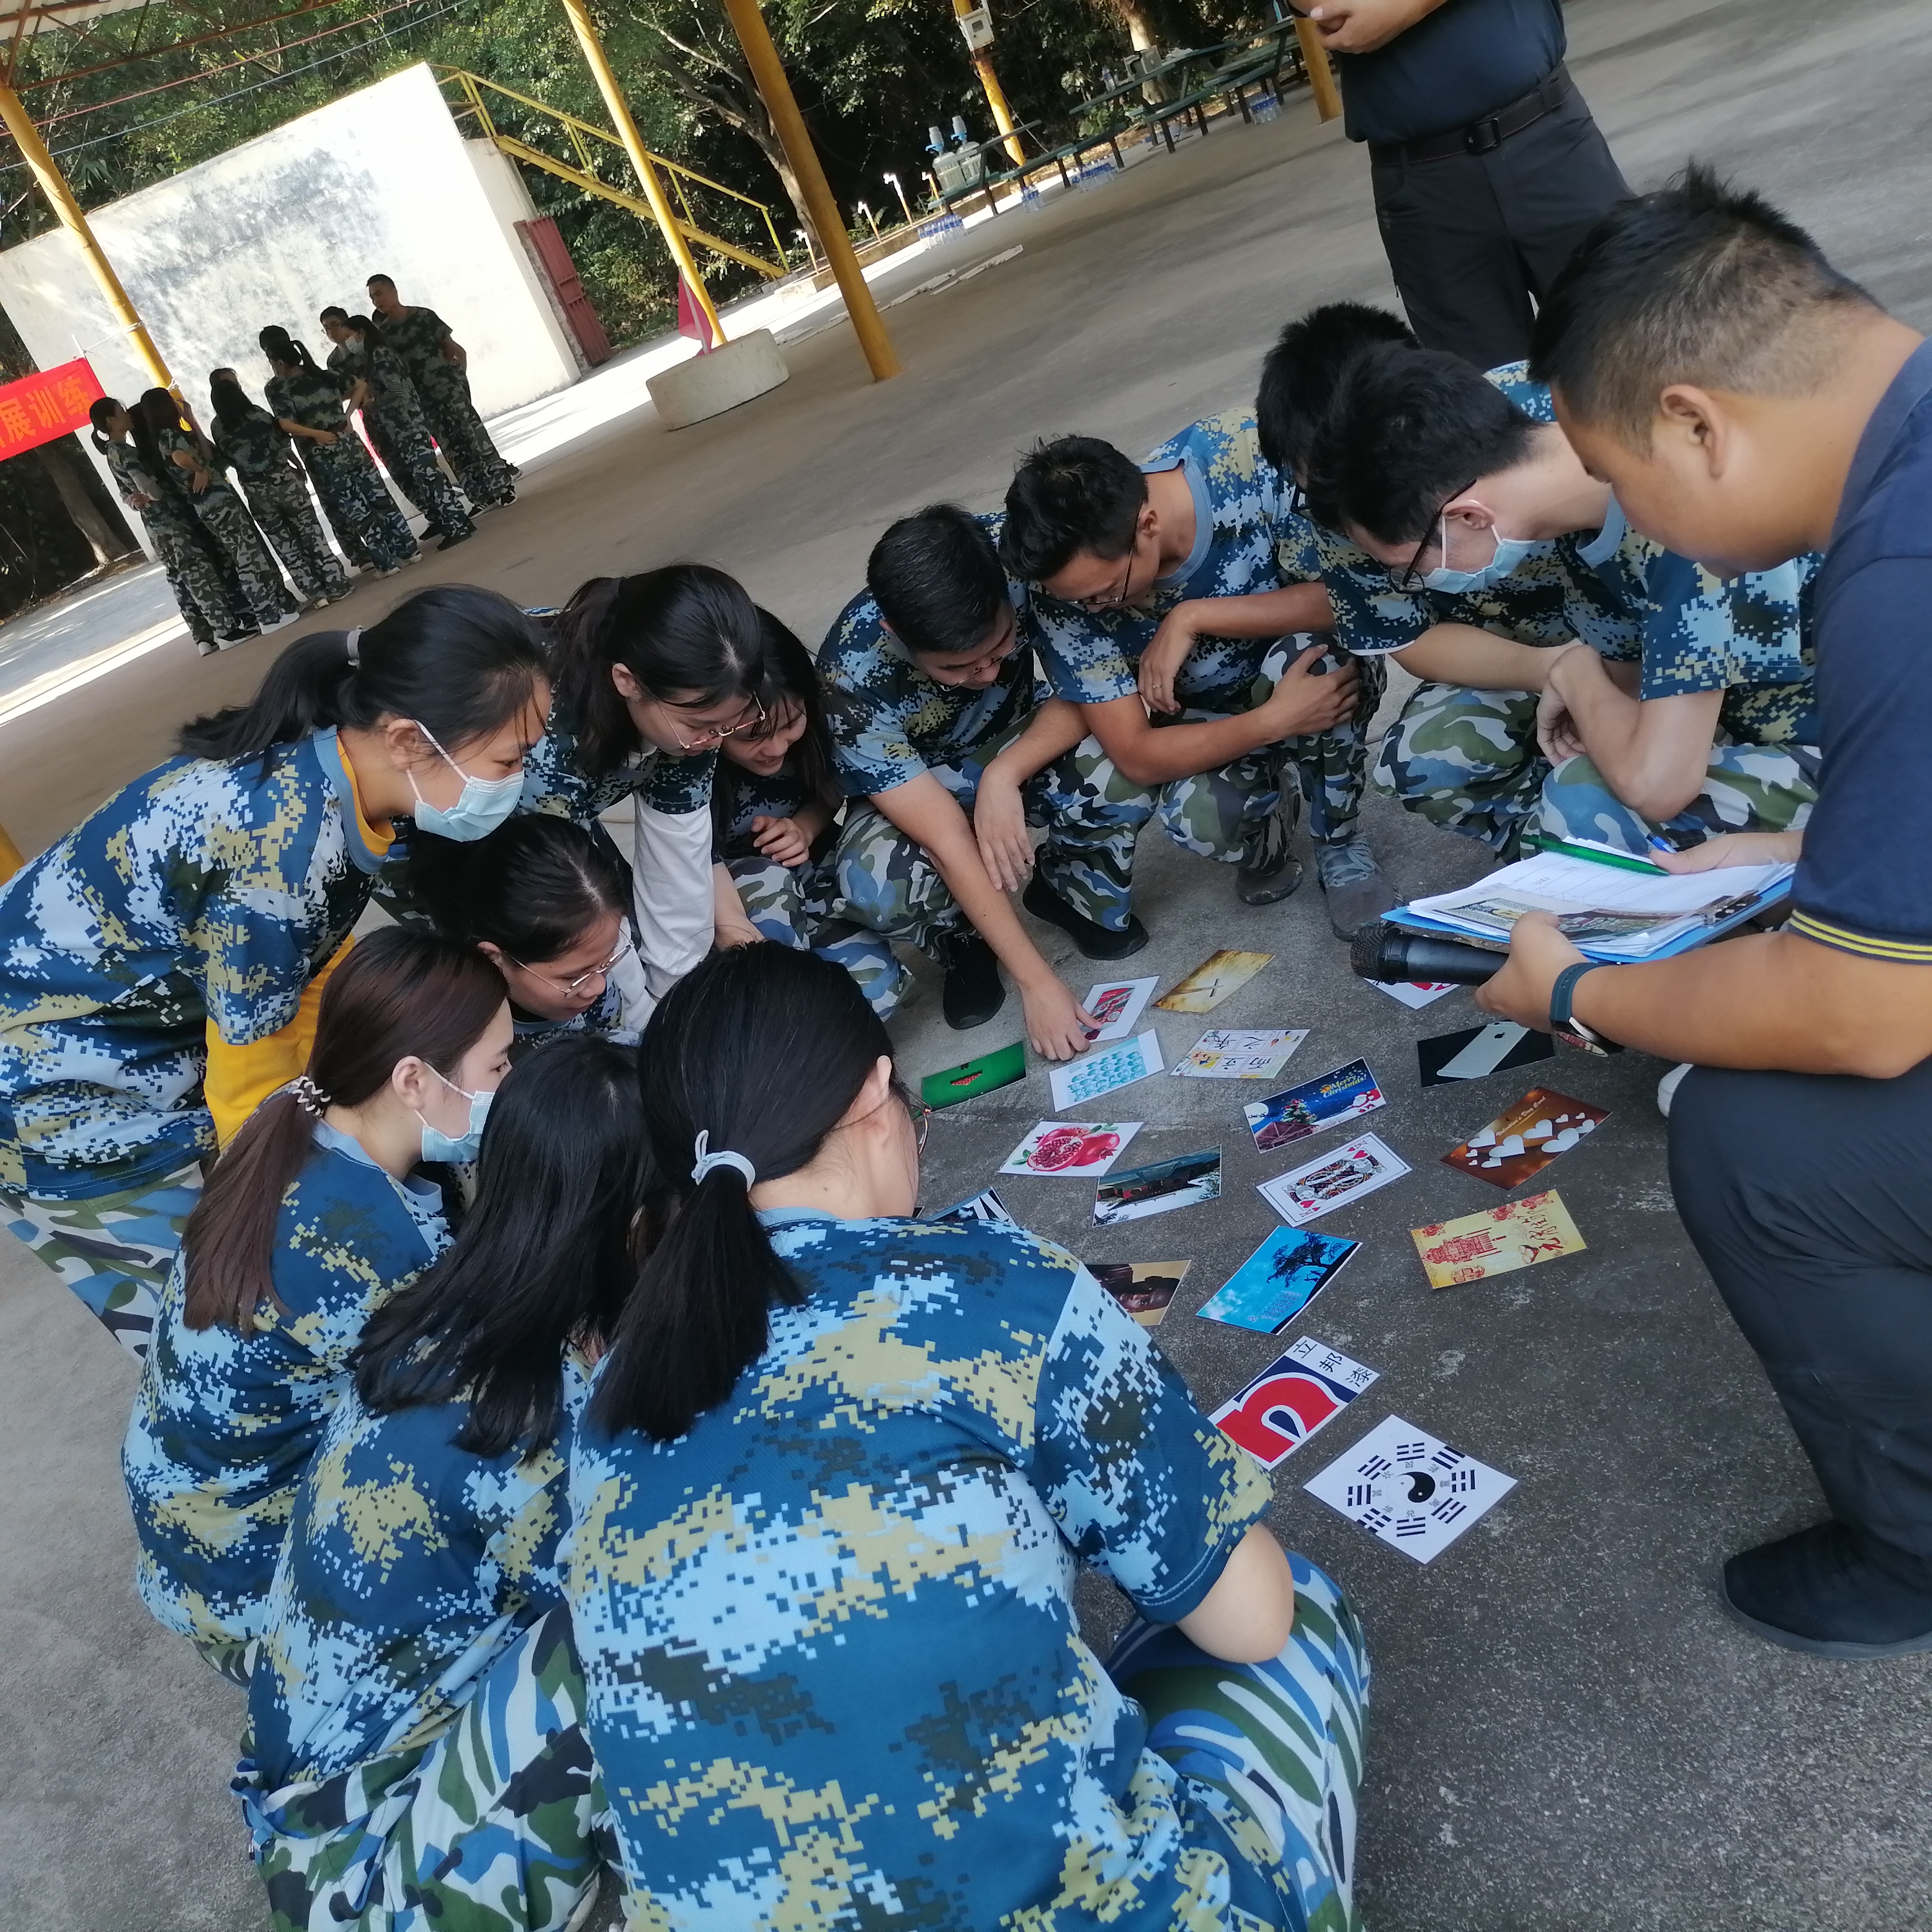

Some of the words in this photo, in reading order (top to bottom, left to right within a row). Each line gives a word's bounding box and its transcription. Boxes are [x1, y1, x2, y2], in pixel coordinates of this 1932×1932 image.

[0, 376, 93, 448] 展训练
[1331, 1075, 1357, 1089] Merry
[1496, 1116, 1522, 1136] Valentine's
[1521, 1107, 1534, 1116] Day
[1533, 1096, 1547, 1108] Card
[1355, 1140, 1368, 1149] K
[1299, 1209, 1313, 1217] K
[1293, 1340, 1372, 1387] 立邦漆
